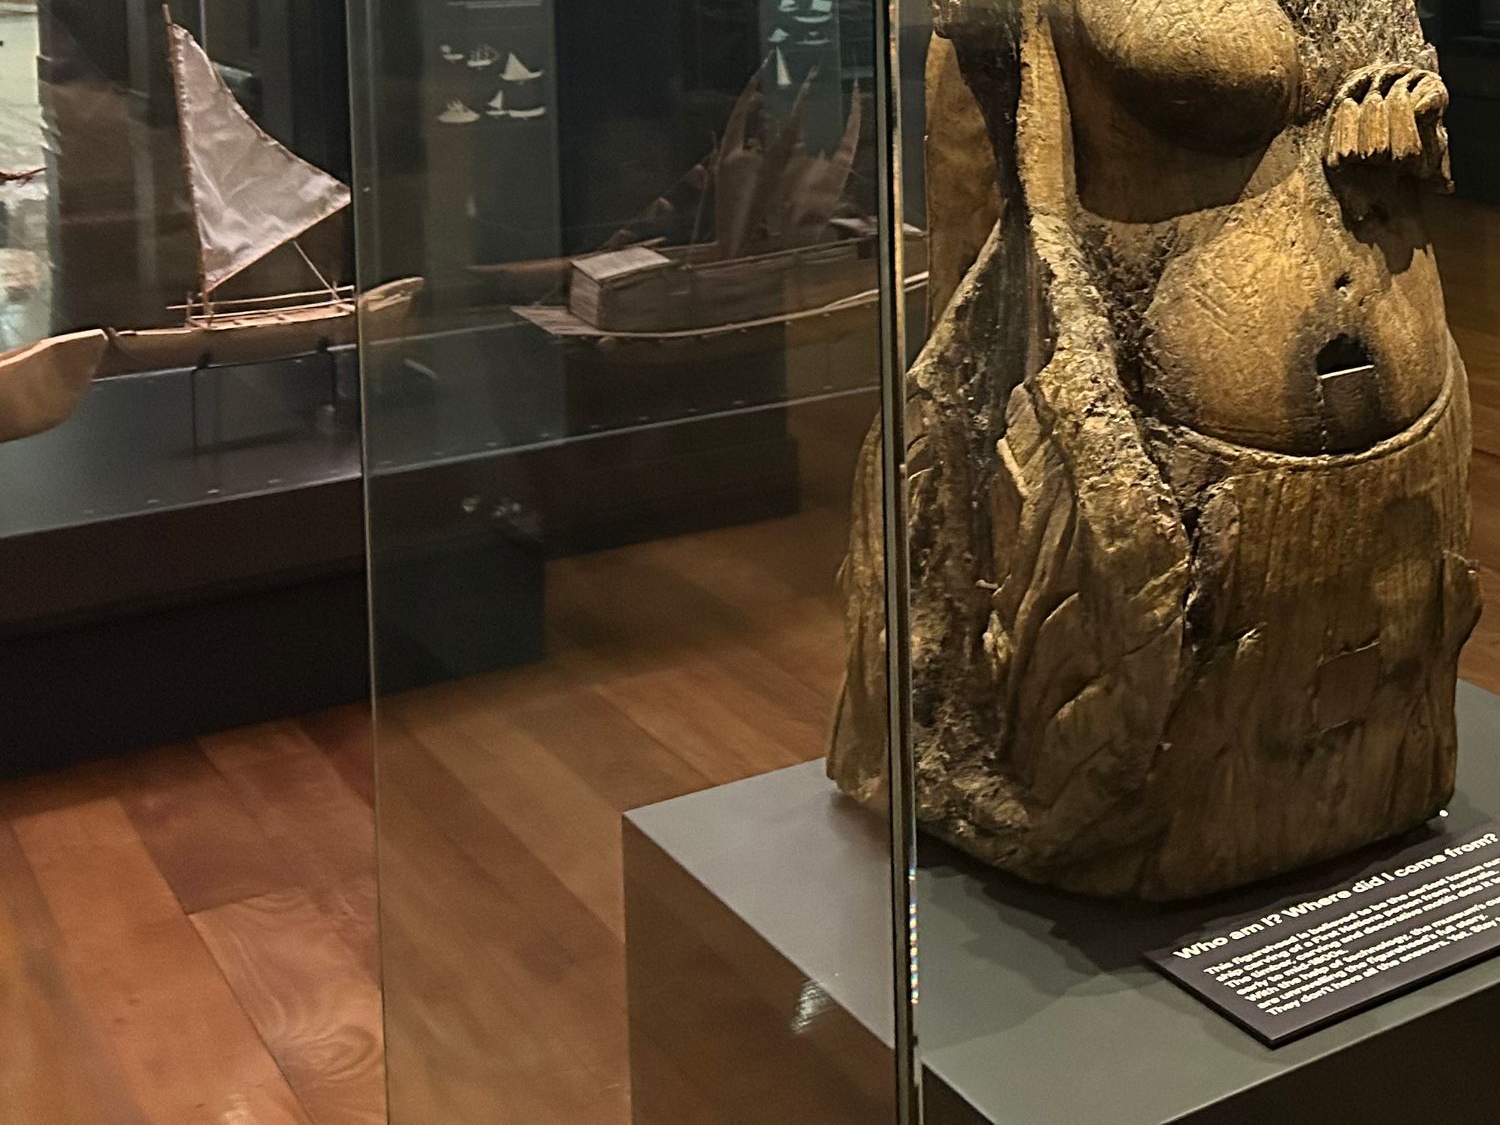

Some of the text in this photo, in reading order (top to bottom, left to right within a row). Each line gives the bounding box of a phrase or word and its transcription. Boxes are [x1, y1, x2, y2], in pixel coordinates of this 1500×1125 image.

[1172, 833, 1498, 958] Who am I? Where did I come from?
[1203, 962, 1233, 974] This
[1231, 935, 1299, 964] figurehead
[1307, 912, 1358, 934] believed
[1356, 908, 1372, 916] to
[1369, 902, 1388, 910] be
[1385, 894, 1408, 904] the
[1215, 968, 1243, 981] ship
[1243, 950, 1290, 970] carving
[1288, 943, 1303, 952] of
[1310, 929, 1341, 943] First
[1337, 913, 1384, 933] Nations
[1382, 898, 1423, 917] person
[1420, 887, 1450, 901] from
[1223, 975, 1252, 987] The
[1295, 940, 1341, 960] carving
[1339, 930, 1364, 943] and
[1362, 908, 1423, 934] decorative
[1457, 884, 1483, 897] date
[1236, 979, 1268, 994] early
[1266, 973, 1284, 981] to
[1244, 985, 1279, 1001] With
[1276, 977, 1301, 988] the
[1298, 966, 1329, 980] help
[1328, 958, 1343, 968] of
[1409, 924, 1432, 935] the
[1256, 997, 1280, 1008] are
[1343, 961, 1367, 972] the
[1434, 924, 1457, 936] full
[1265, 999, 1300, 1015] They
[1330, 974, 1363, 989] have
[1362, 966, 1379, 977] all
[1376, 959, 1400, 970] the
[1469, 919, 1497, 933] Stay
